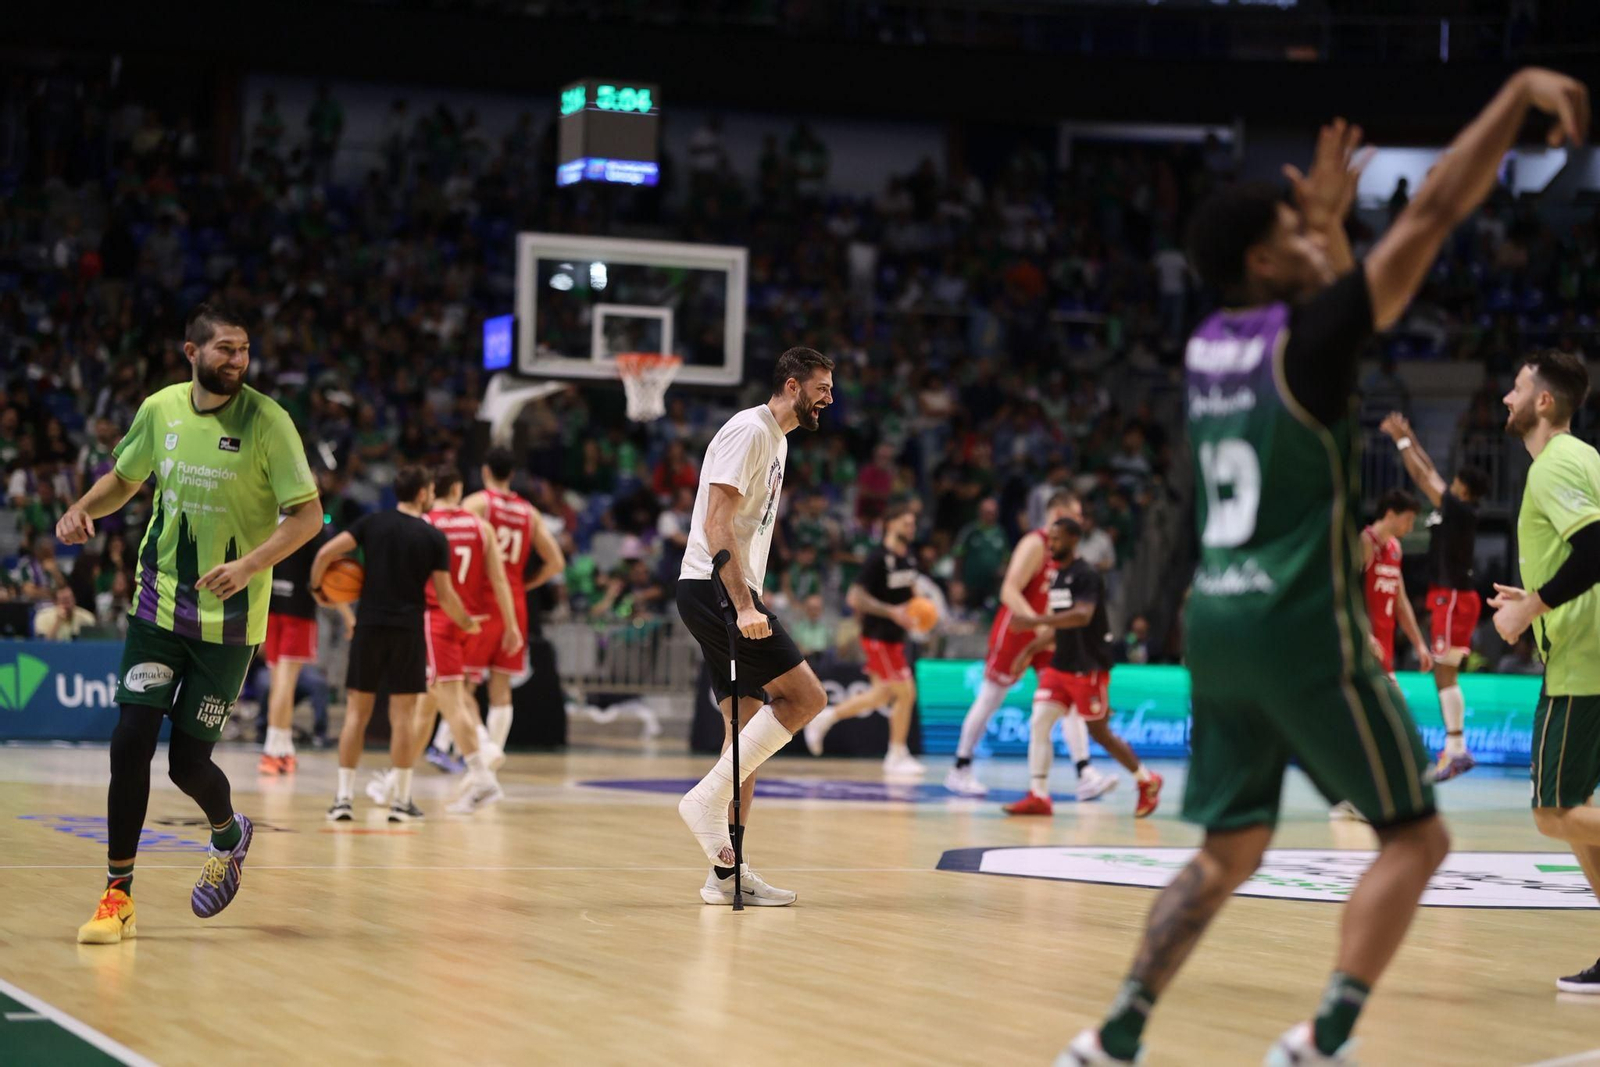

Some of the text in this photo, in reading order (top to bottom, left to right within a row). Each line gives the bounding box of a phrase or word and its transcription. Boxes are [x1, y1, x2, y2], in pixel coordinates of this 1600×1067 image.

[177, 461, 237, 480] Fundación
[177, 473, 218, 491] Unicaja
[497, 525, 523, 564] 21
[454, 545, 472, 584] 7
[197, 708, 222, 728] laga
